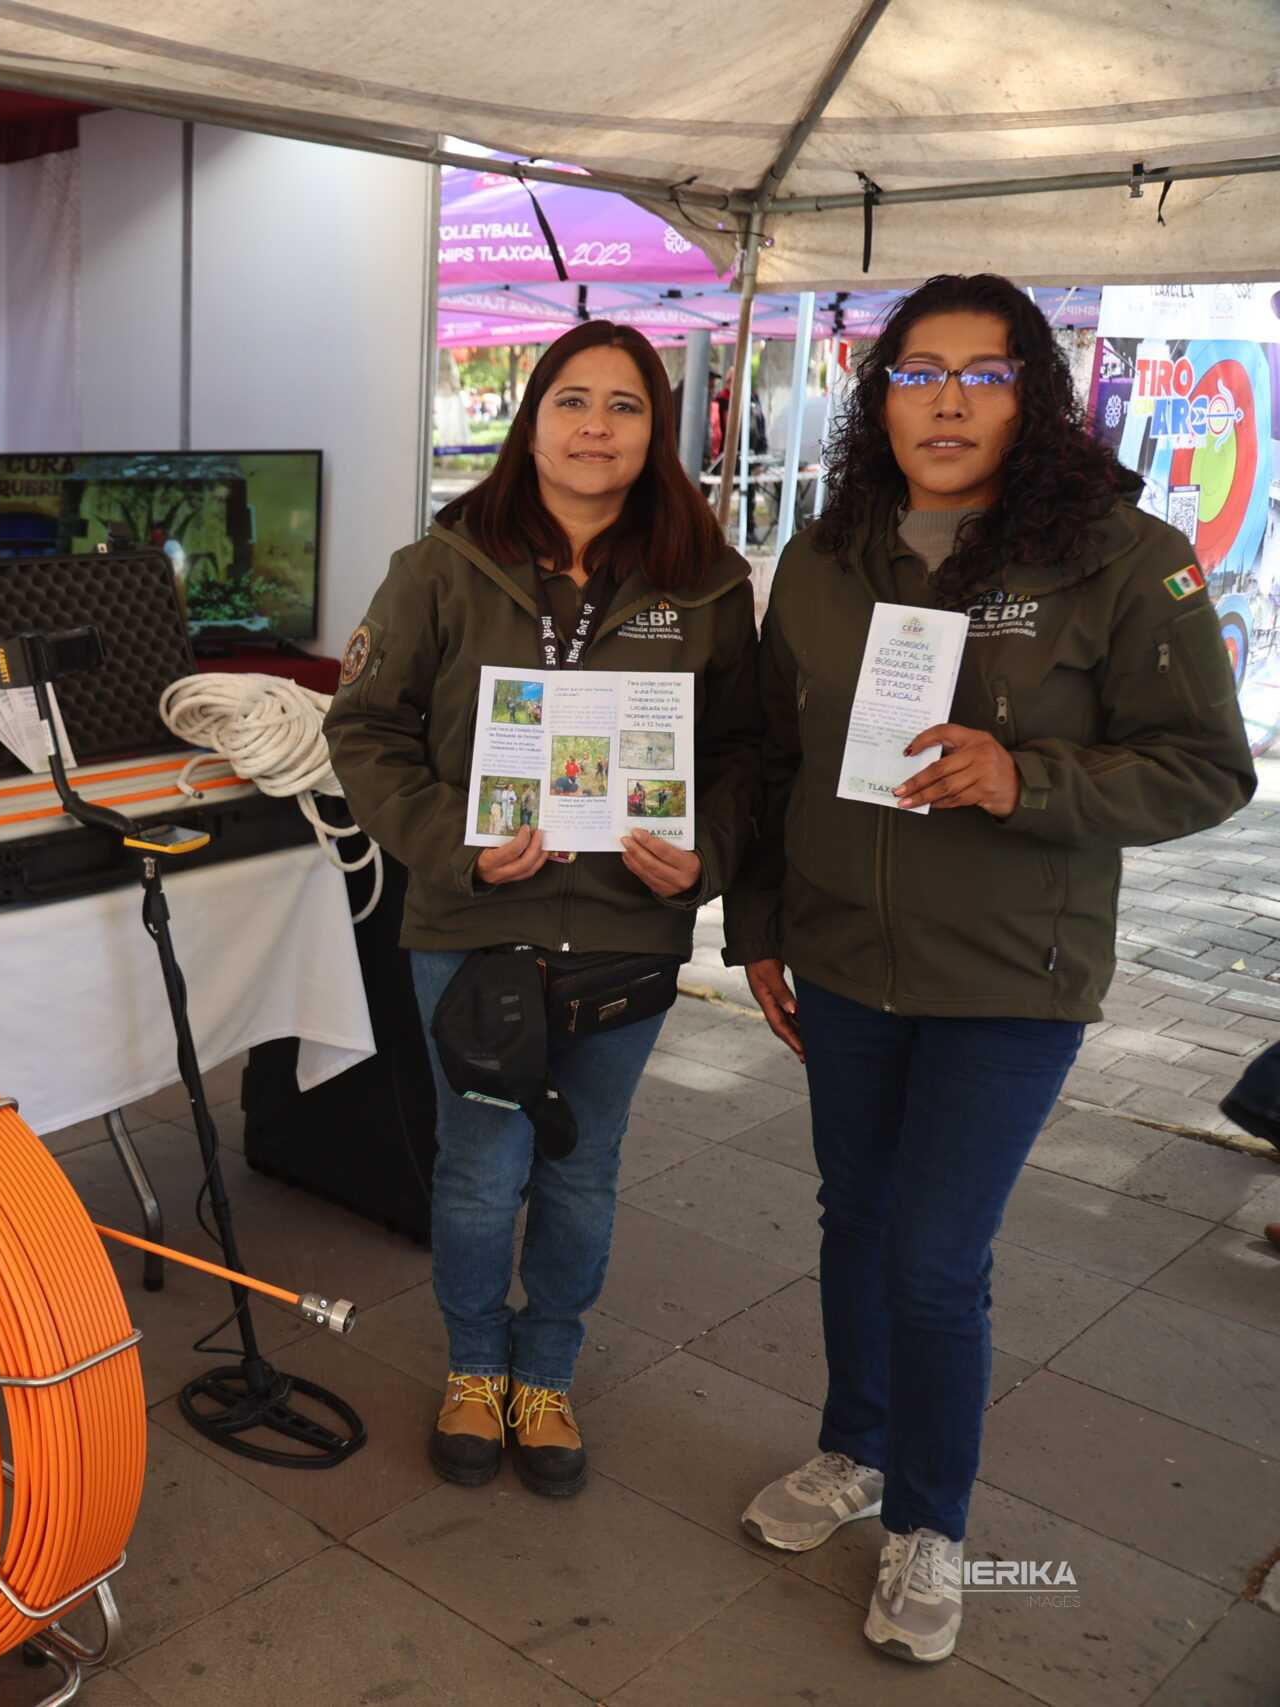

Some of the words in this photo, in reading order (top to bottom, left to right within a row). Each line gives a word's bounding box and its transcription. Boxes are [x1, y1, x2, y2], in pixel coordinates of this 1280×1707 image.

[568, 241, 632, 267] 2023
[1135, 356, 1194, 398] TIRO
[967, 601, 1039, 622] CEBP
[879, 648, 920, 661] ESTATAL
[922, 654, 936, 663] DE
[872, 667, 915, 681] PERSONAS
[875, 688, 921, 703] TLAXCALA
[868, 782, 890, 793] TLAX
[646, 829, 684, 837] AXCALA
